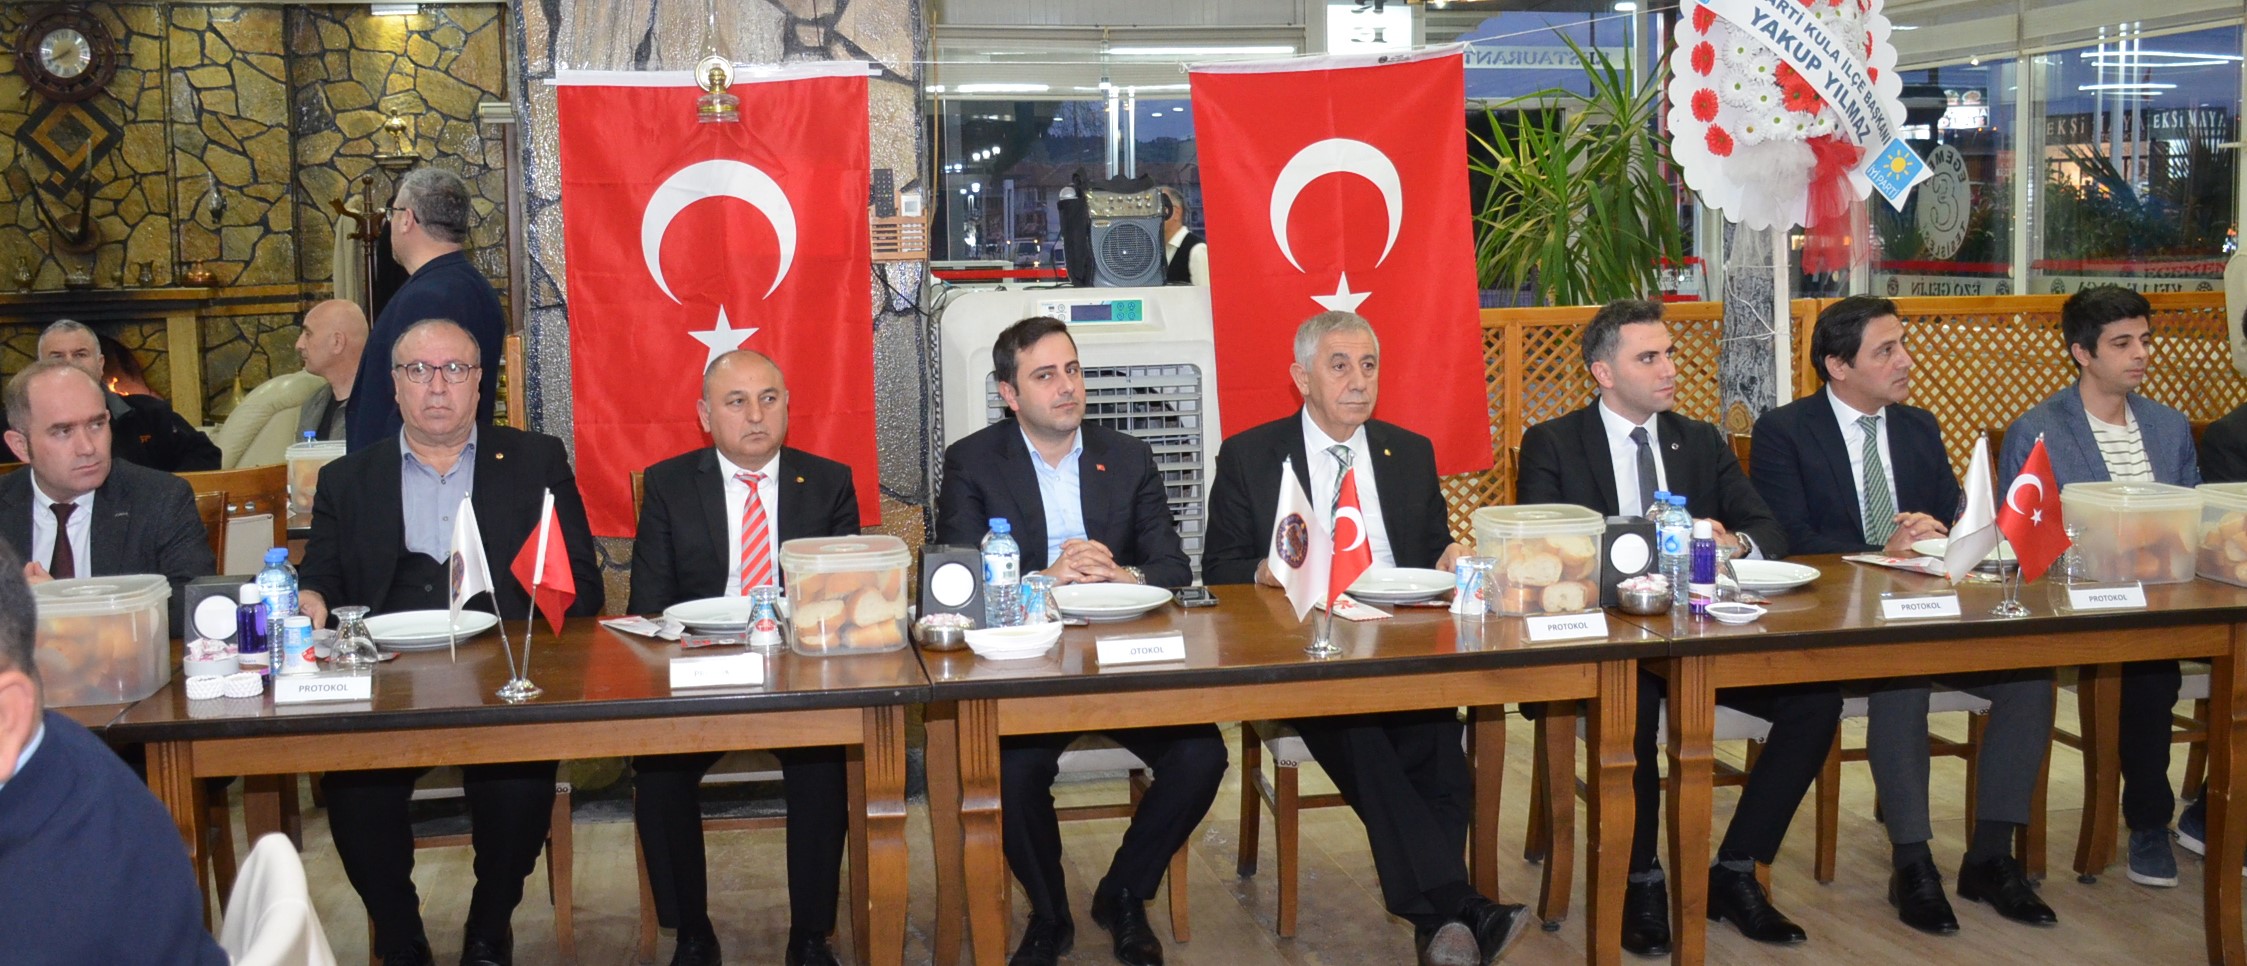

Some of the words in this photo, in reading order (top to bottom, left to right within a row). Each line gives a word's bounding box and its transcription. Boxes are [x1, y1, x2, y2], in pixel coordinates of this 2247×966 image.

[1750, 6, 1822, 71] YAKUP
[1824, 69, 1871, 144] YILMAZ
[1803, 22, 1840, 64] KULA
[1841, 57, 1867, 94] İLÇE
[1863, 90, 1892, 146] BAŞKANI
[1866, 163, 1882, 180] İYİ
[1875, 174, 1901, 199] PARTİ
[2088, 594, 2128, 602] PROTOKOL
[1900, 602, 1942, 611] PROTOKOL
[1547, 621, 1589, 631] PROTOKOL
[1129, 646, 1165, 656] OTOKOL
[298, 683, 349, 693] PROTOKOL
